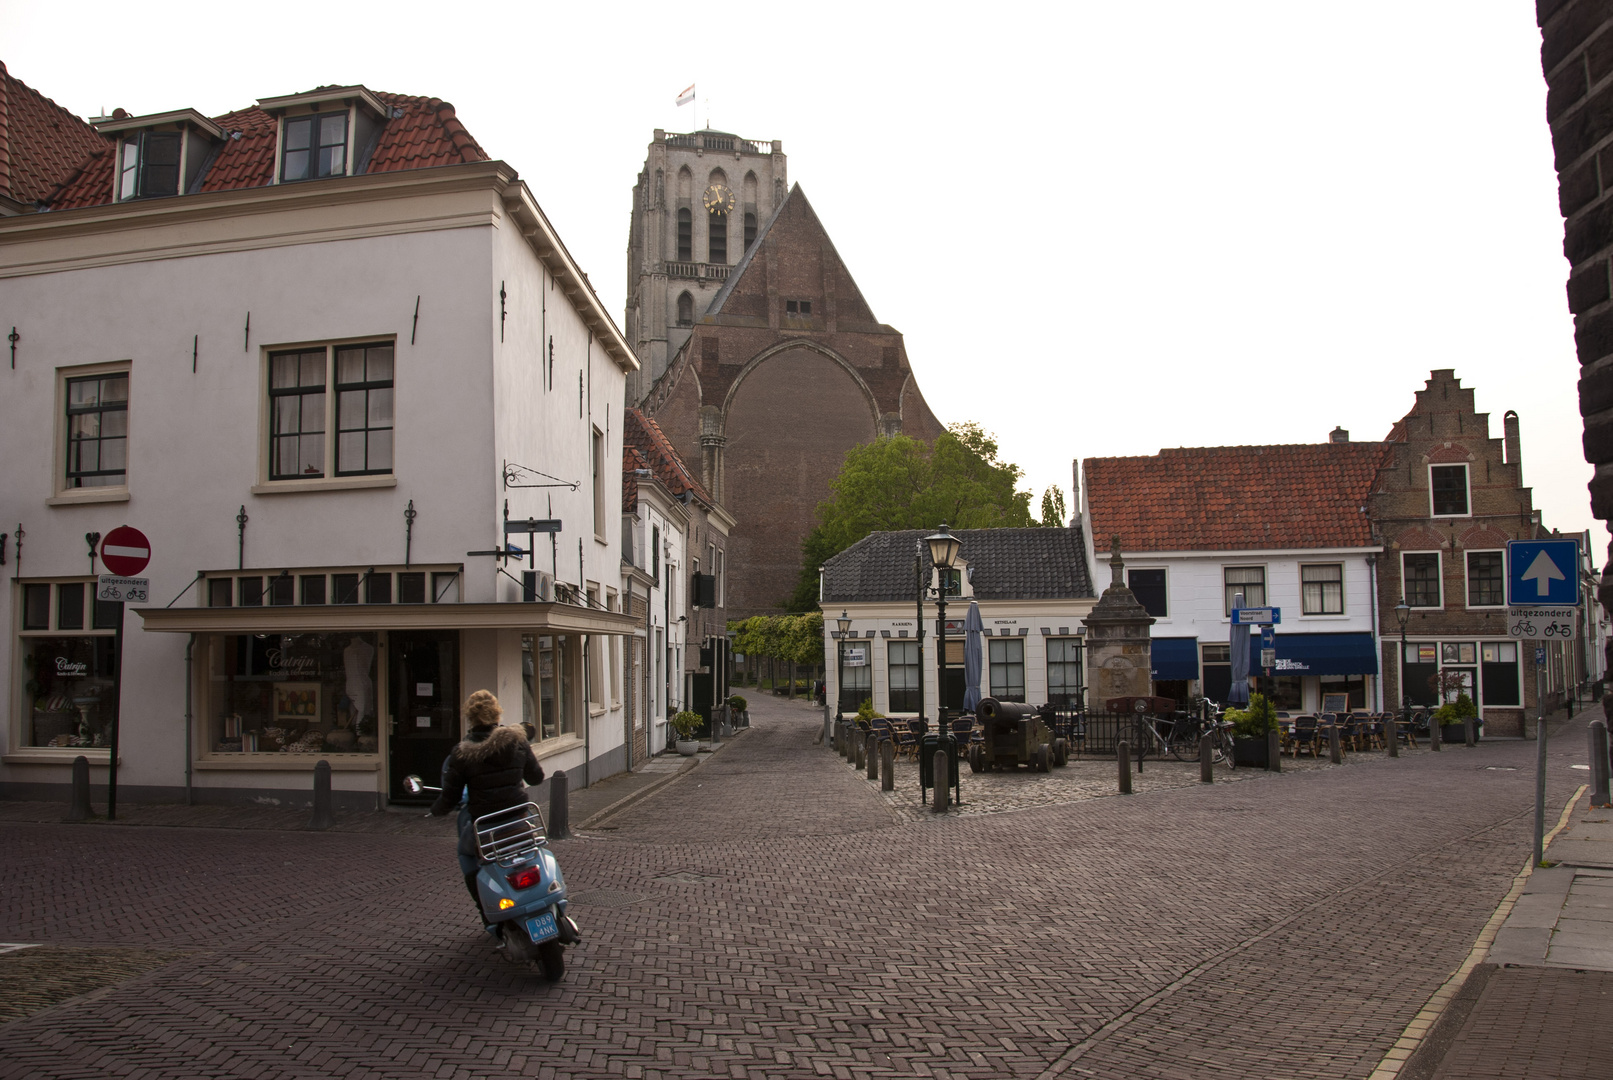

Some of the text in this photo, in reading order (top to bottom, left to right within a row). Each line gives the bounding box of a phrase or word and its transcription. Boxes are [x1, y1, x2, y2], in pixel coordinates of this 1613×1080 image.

[1511, 609, 1572, 618] uitgezonderd
[55, 656, 87, 672] Catrijn
[265, 648, 314, 673] Catrijn
[535, 915, 551, 927] D89
[539, 925, 555, 936] 4NK
